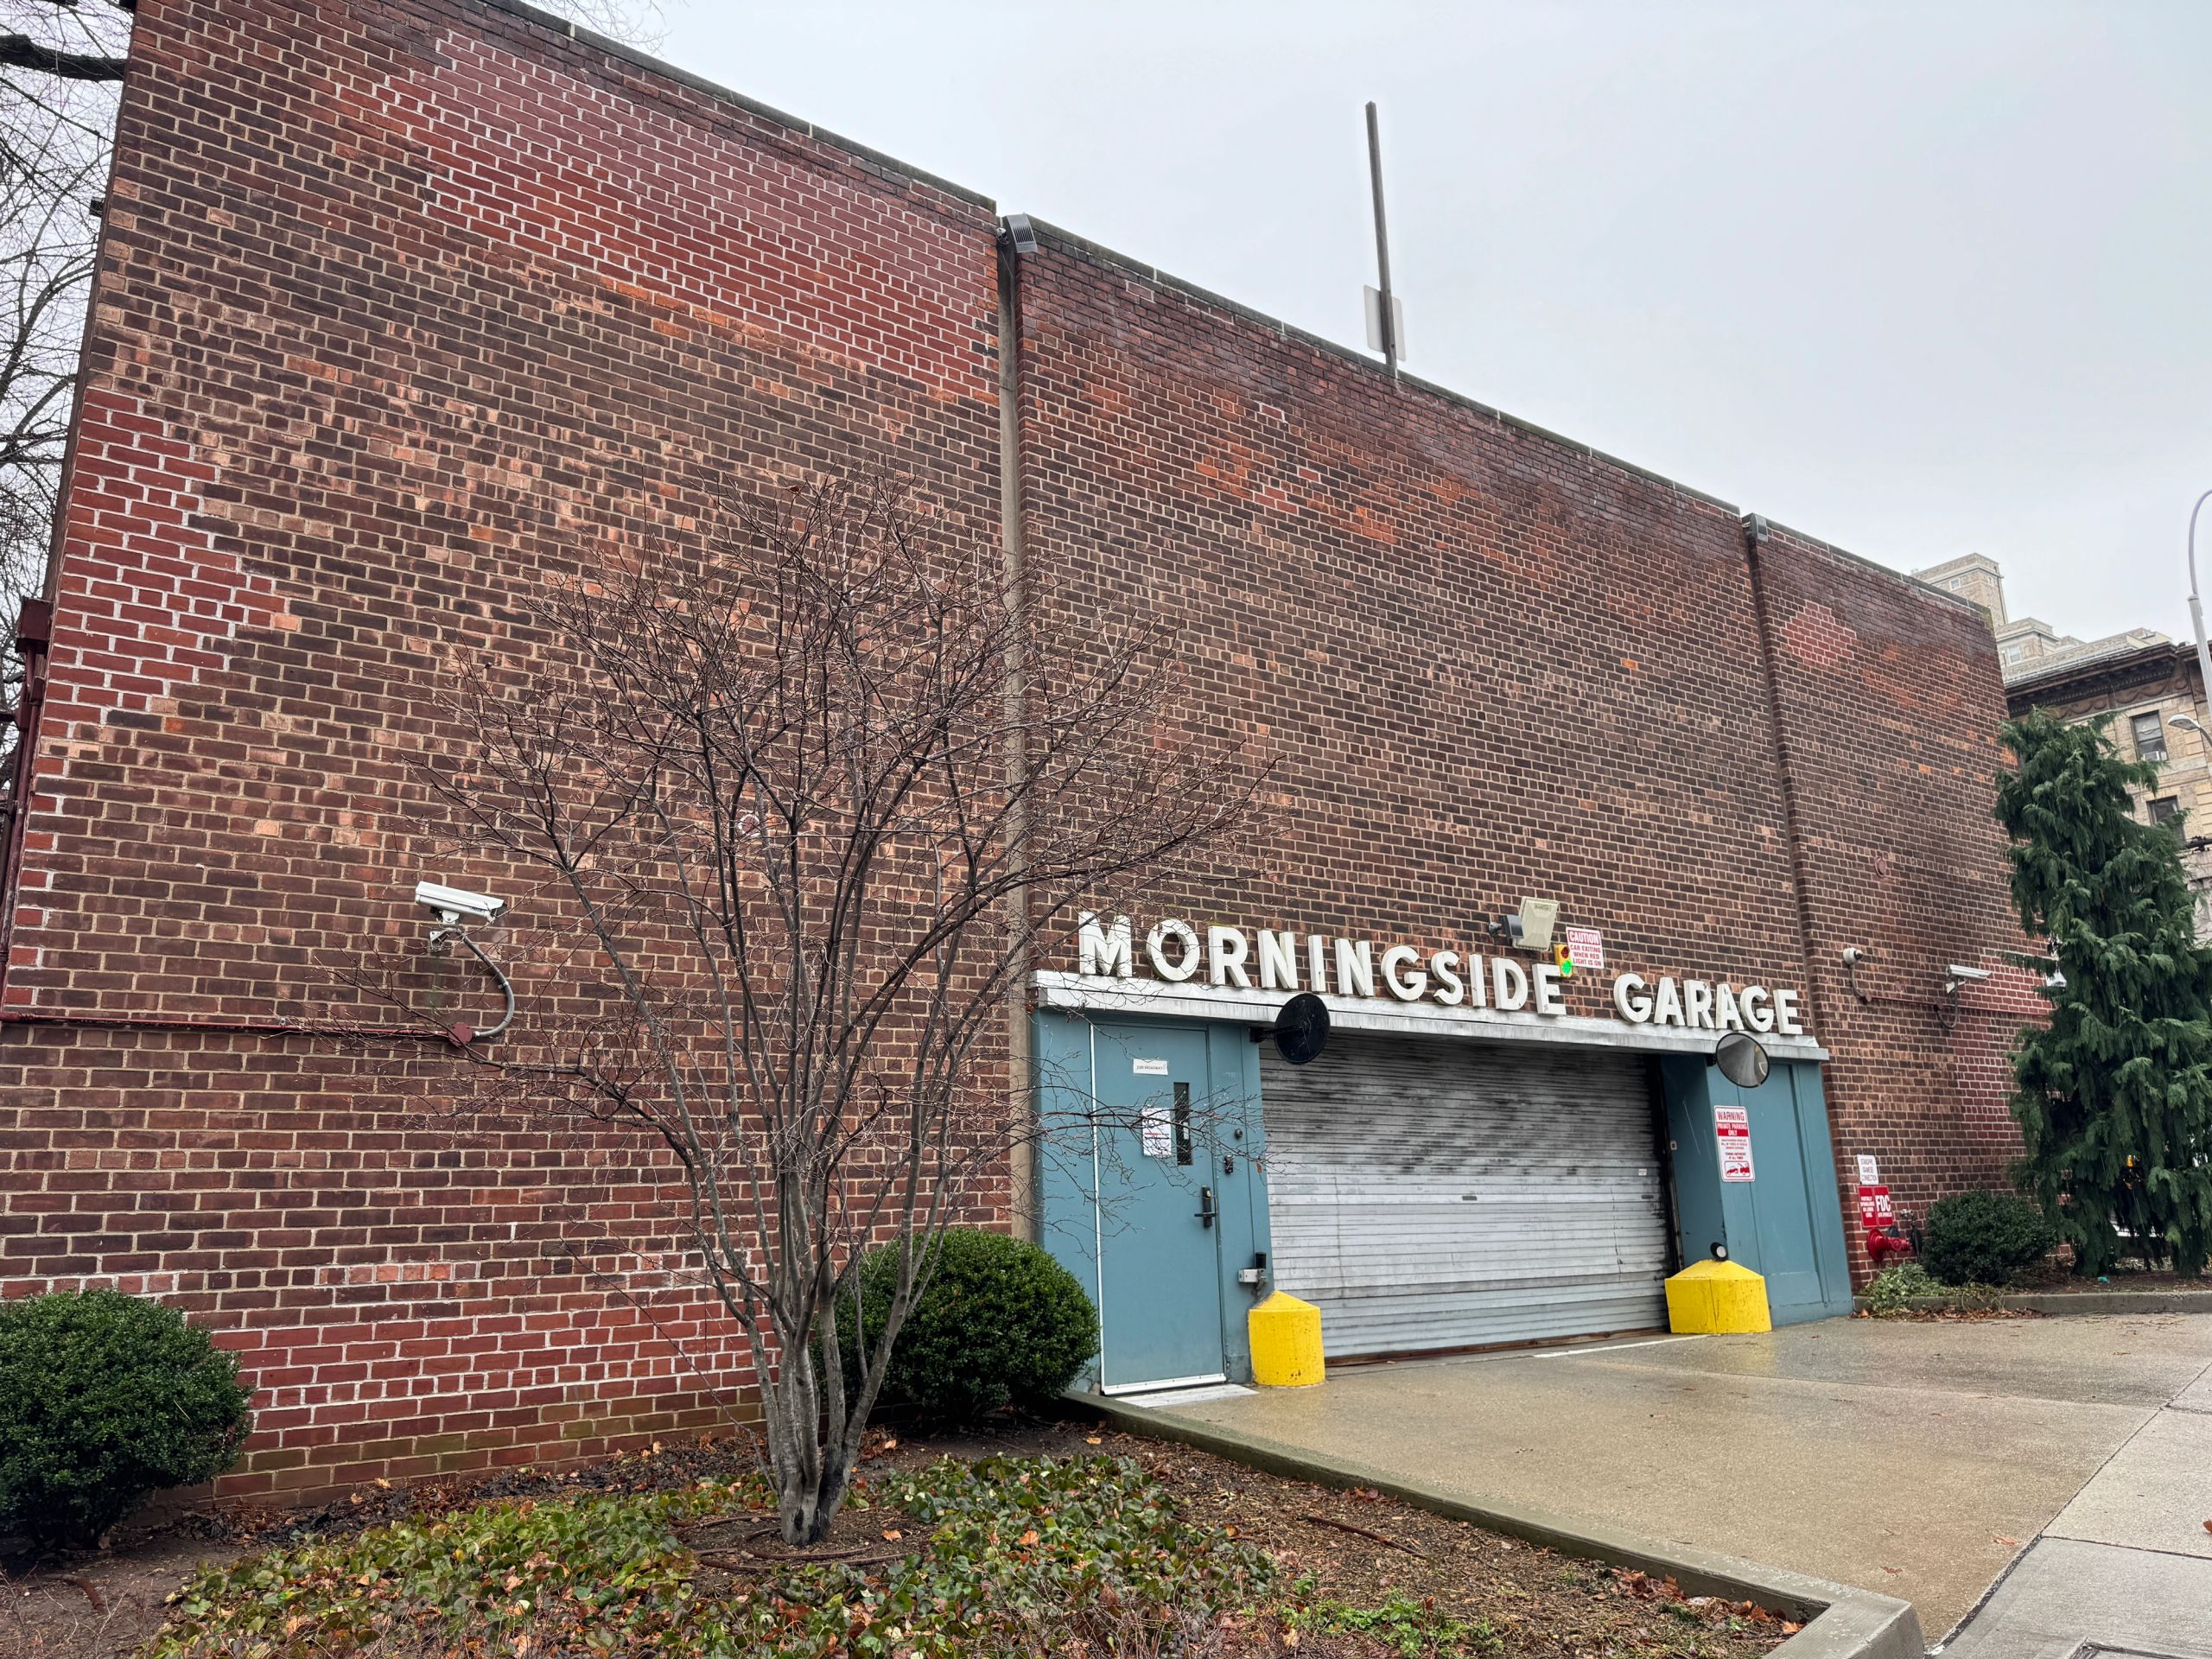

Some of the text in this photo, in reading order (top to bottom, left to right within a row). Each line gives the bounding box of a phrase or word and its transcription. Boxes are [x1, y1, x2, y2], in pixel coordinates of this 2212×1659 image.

[1569, 931, 1599, 944] CAUTION
[1077, 907, 1803, 1035] MORNINGSIDE GARAGE
[1717, 1111, 1744, 1121] WARNING
[1875, 1195, 1891, 1211] FDC
